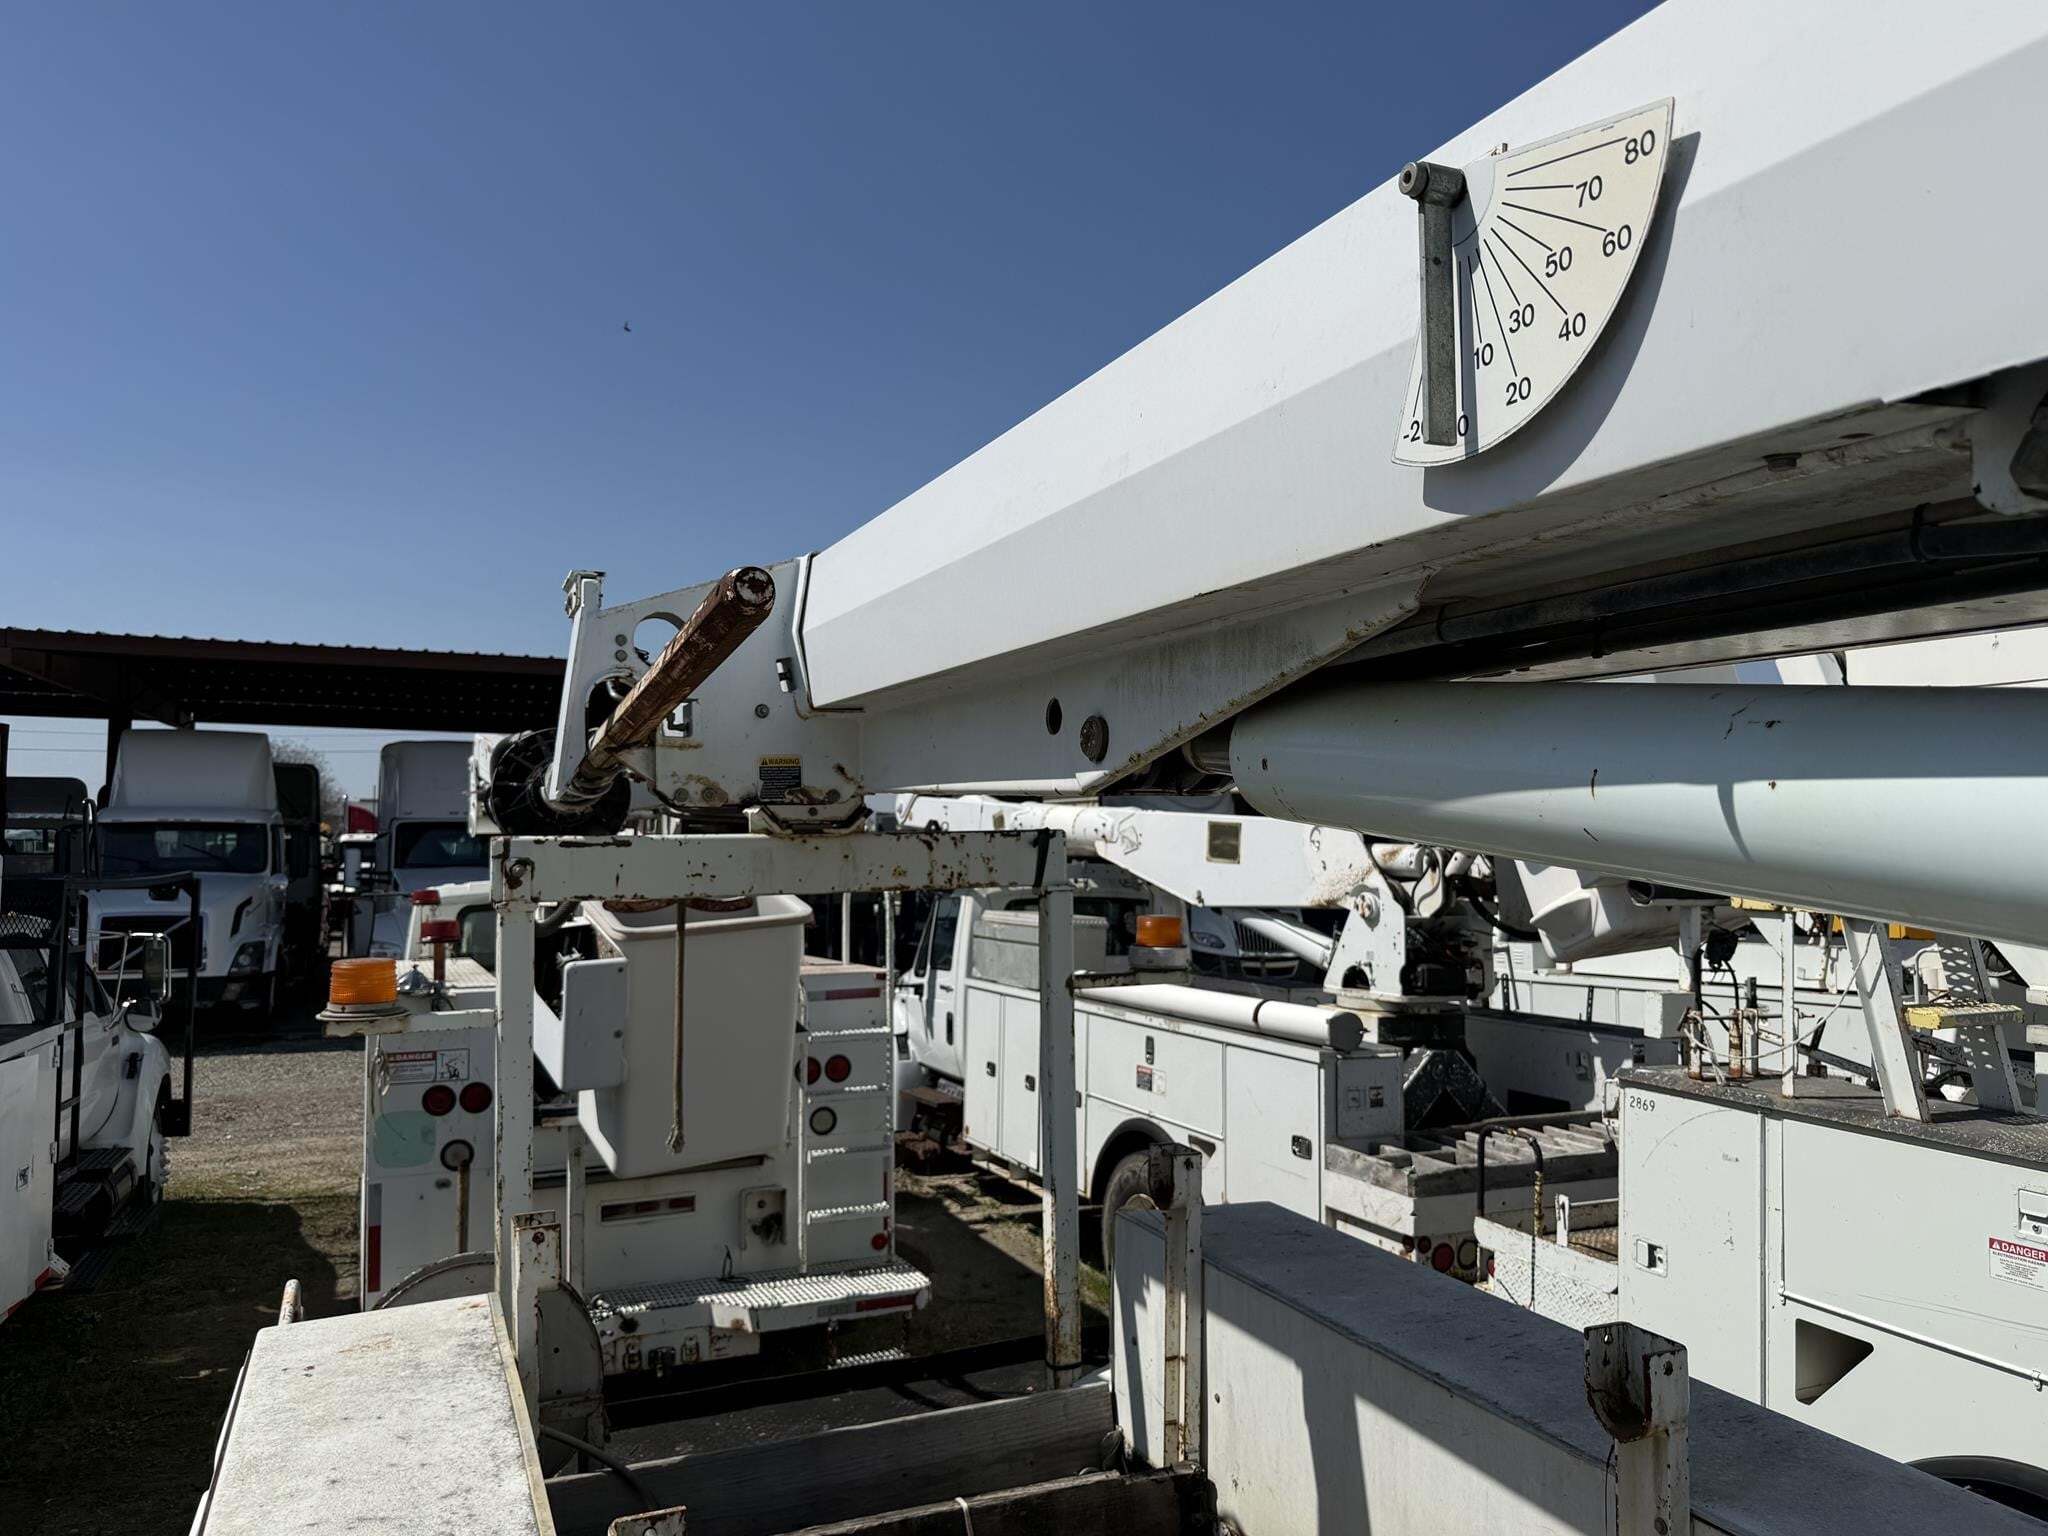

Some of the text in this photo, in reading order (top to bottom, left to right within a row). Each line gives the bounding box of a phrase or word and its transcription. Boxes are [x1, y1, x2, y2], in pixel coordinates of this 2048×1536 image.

[1624, 129, 1656, 165] 80
[1575, 175, 1603, 208] 70
[1602, 224, 1632, 257] 60
[1545, 246, 1573, 278] 50
[1509, 303, 1535, 333] 30
[1558, 312, 1587, 342] 40
[1473, 342, 1494, 369] 10
[1505, 377, 1532, 406] 20
[1403, 420, 1424, 442] -2
[1629, 1095, 1656, 1112] 2869
[2001, 1242, 2046, 1260] DANGER
